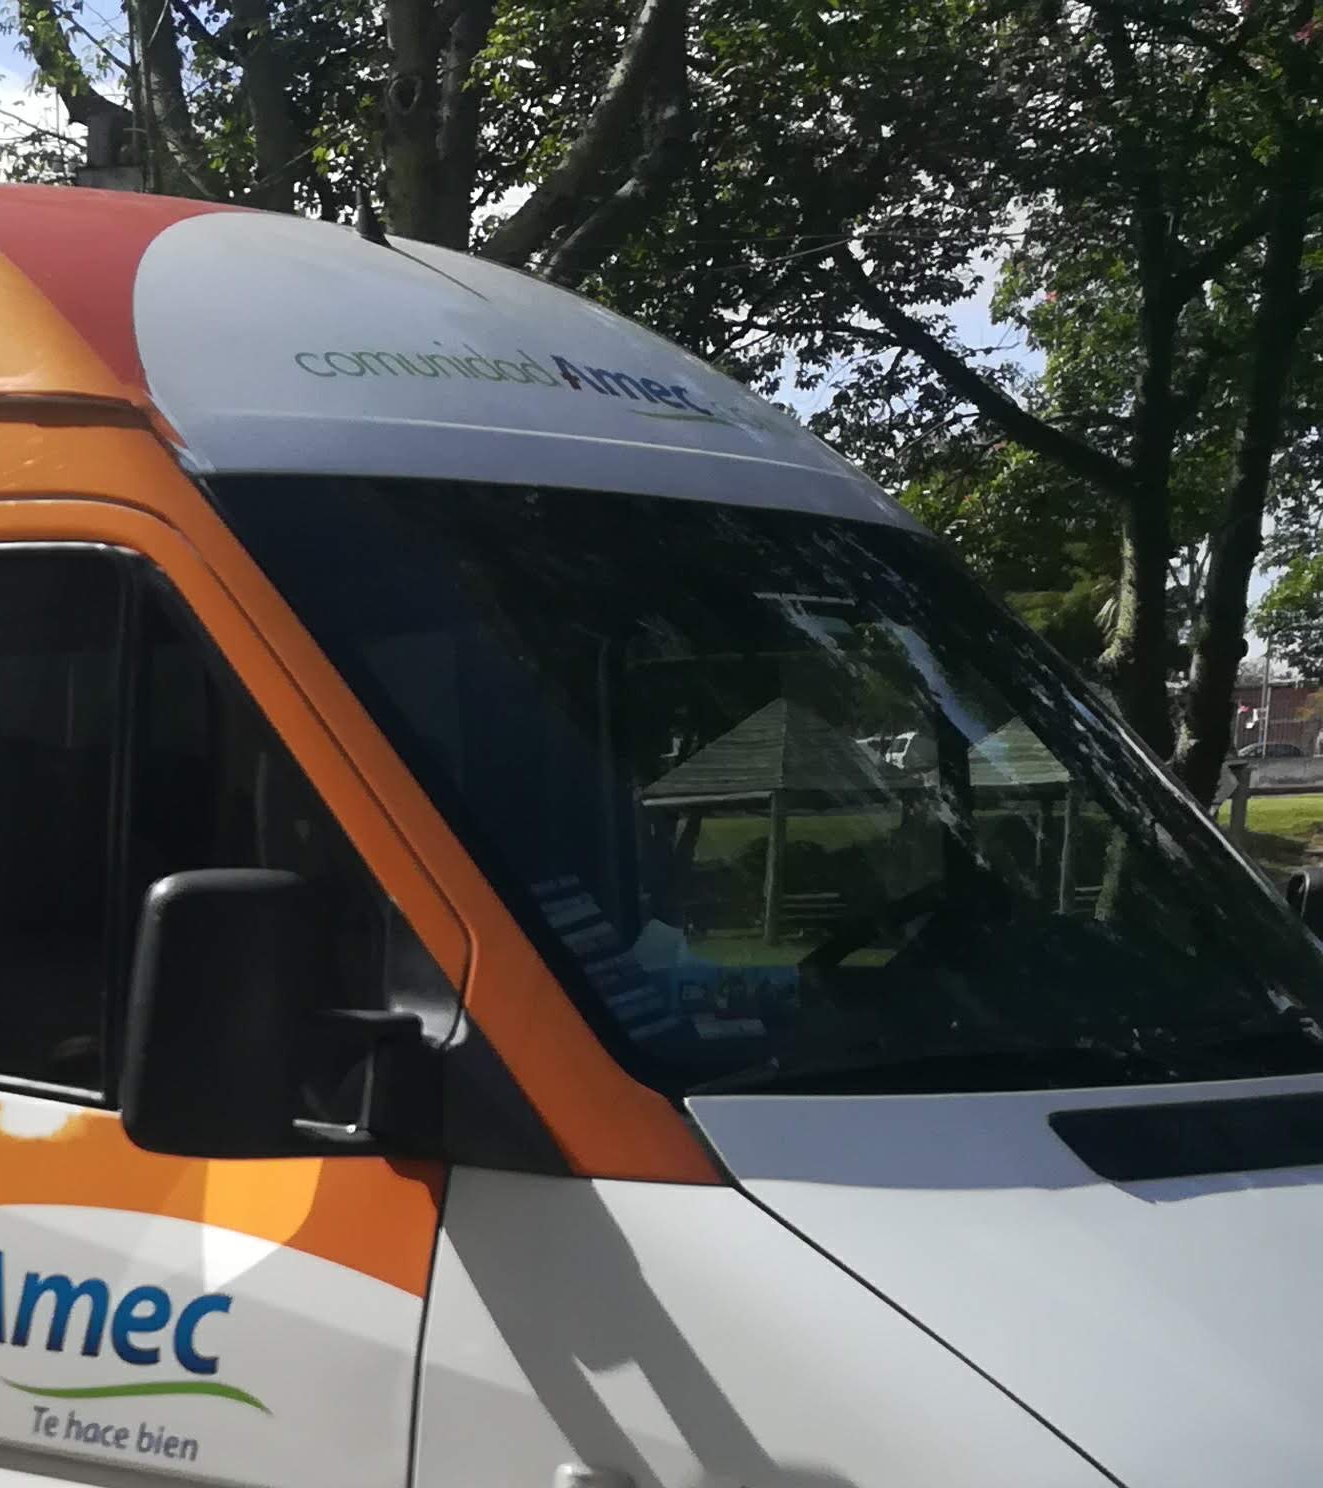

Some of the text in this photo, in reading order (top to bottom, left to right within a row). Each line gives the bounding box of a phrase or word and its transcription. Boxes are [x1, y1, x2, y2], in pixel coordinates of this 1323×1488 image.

[32, 1405, 200, 1462] Te hace bien
